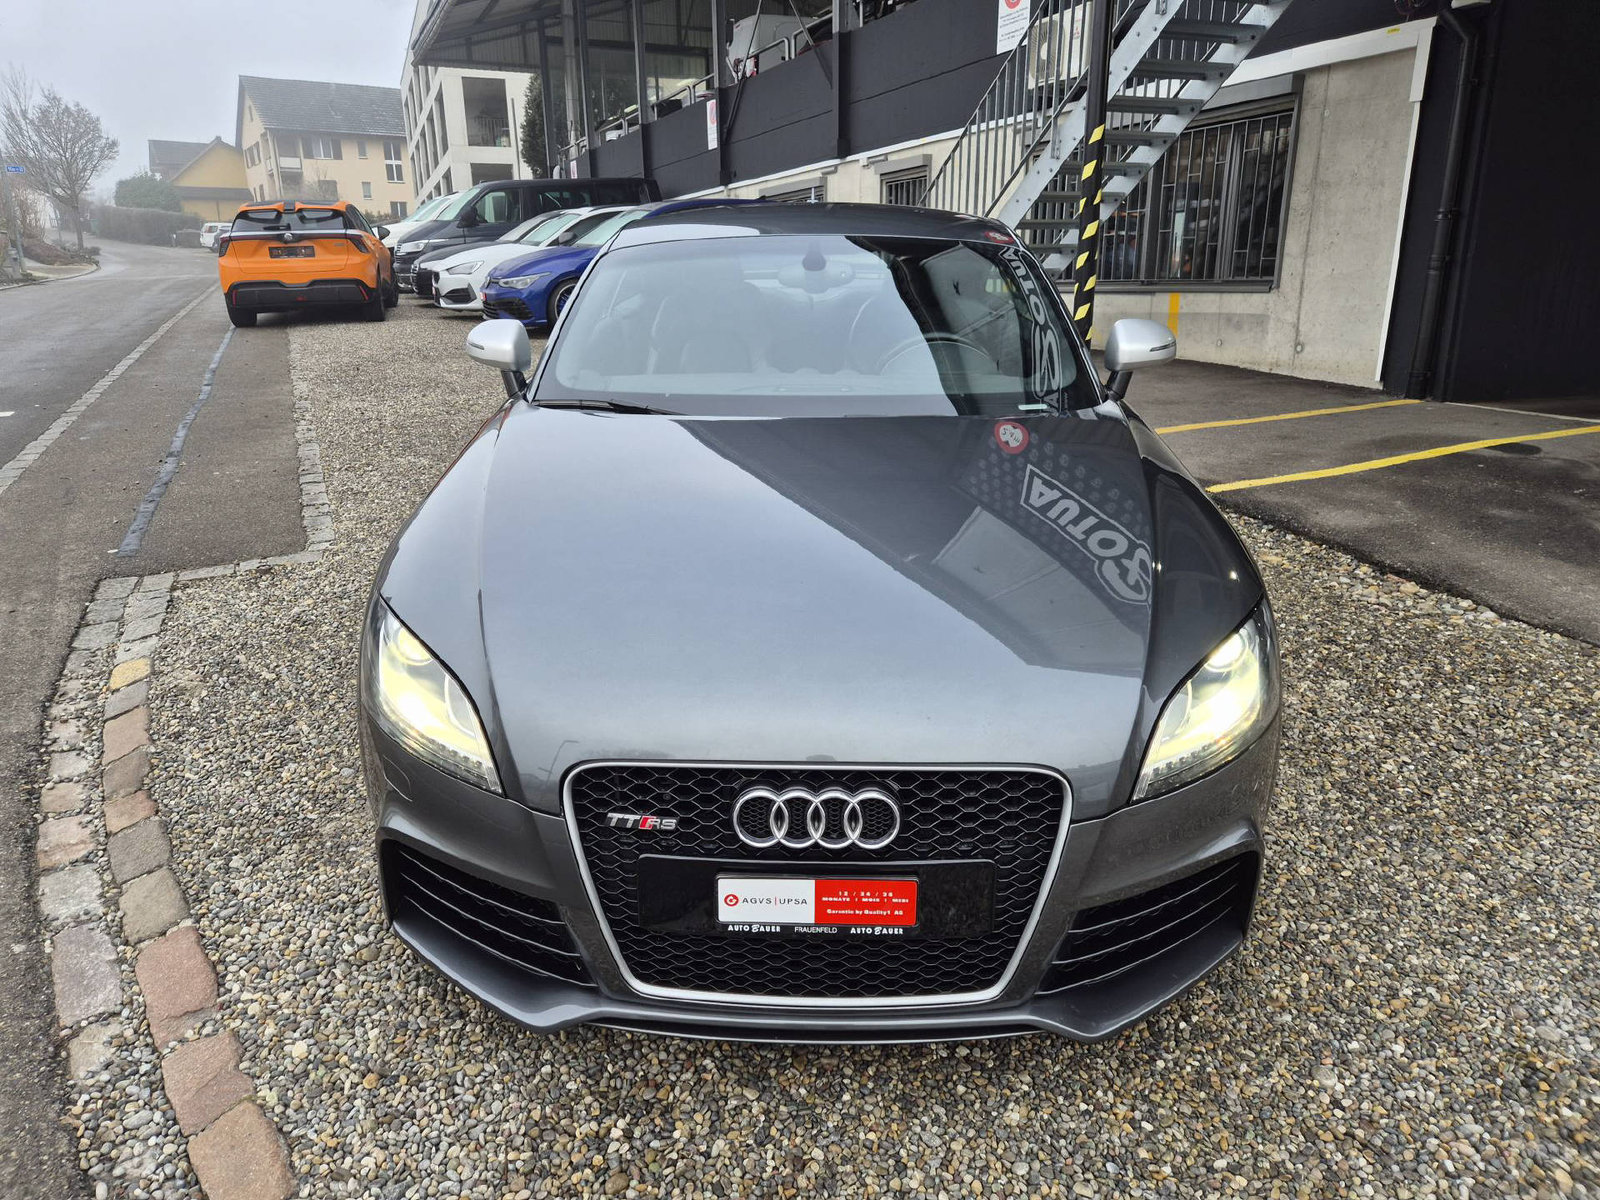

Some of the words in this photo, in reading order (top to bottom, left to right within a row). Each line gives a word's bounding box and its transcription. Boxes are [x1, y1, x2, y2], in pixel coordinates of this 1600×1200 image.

[728, 924, 750, 932] AUTO
[751, 924, 781, 933] BAUER
[850, 927, 872, 935] AUTO
[874, 926, 904, 935] BAUER
